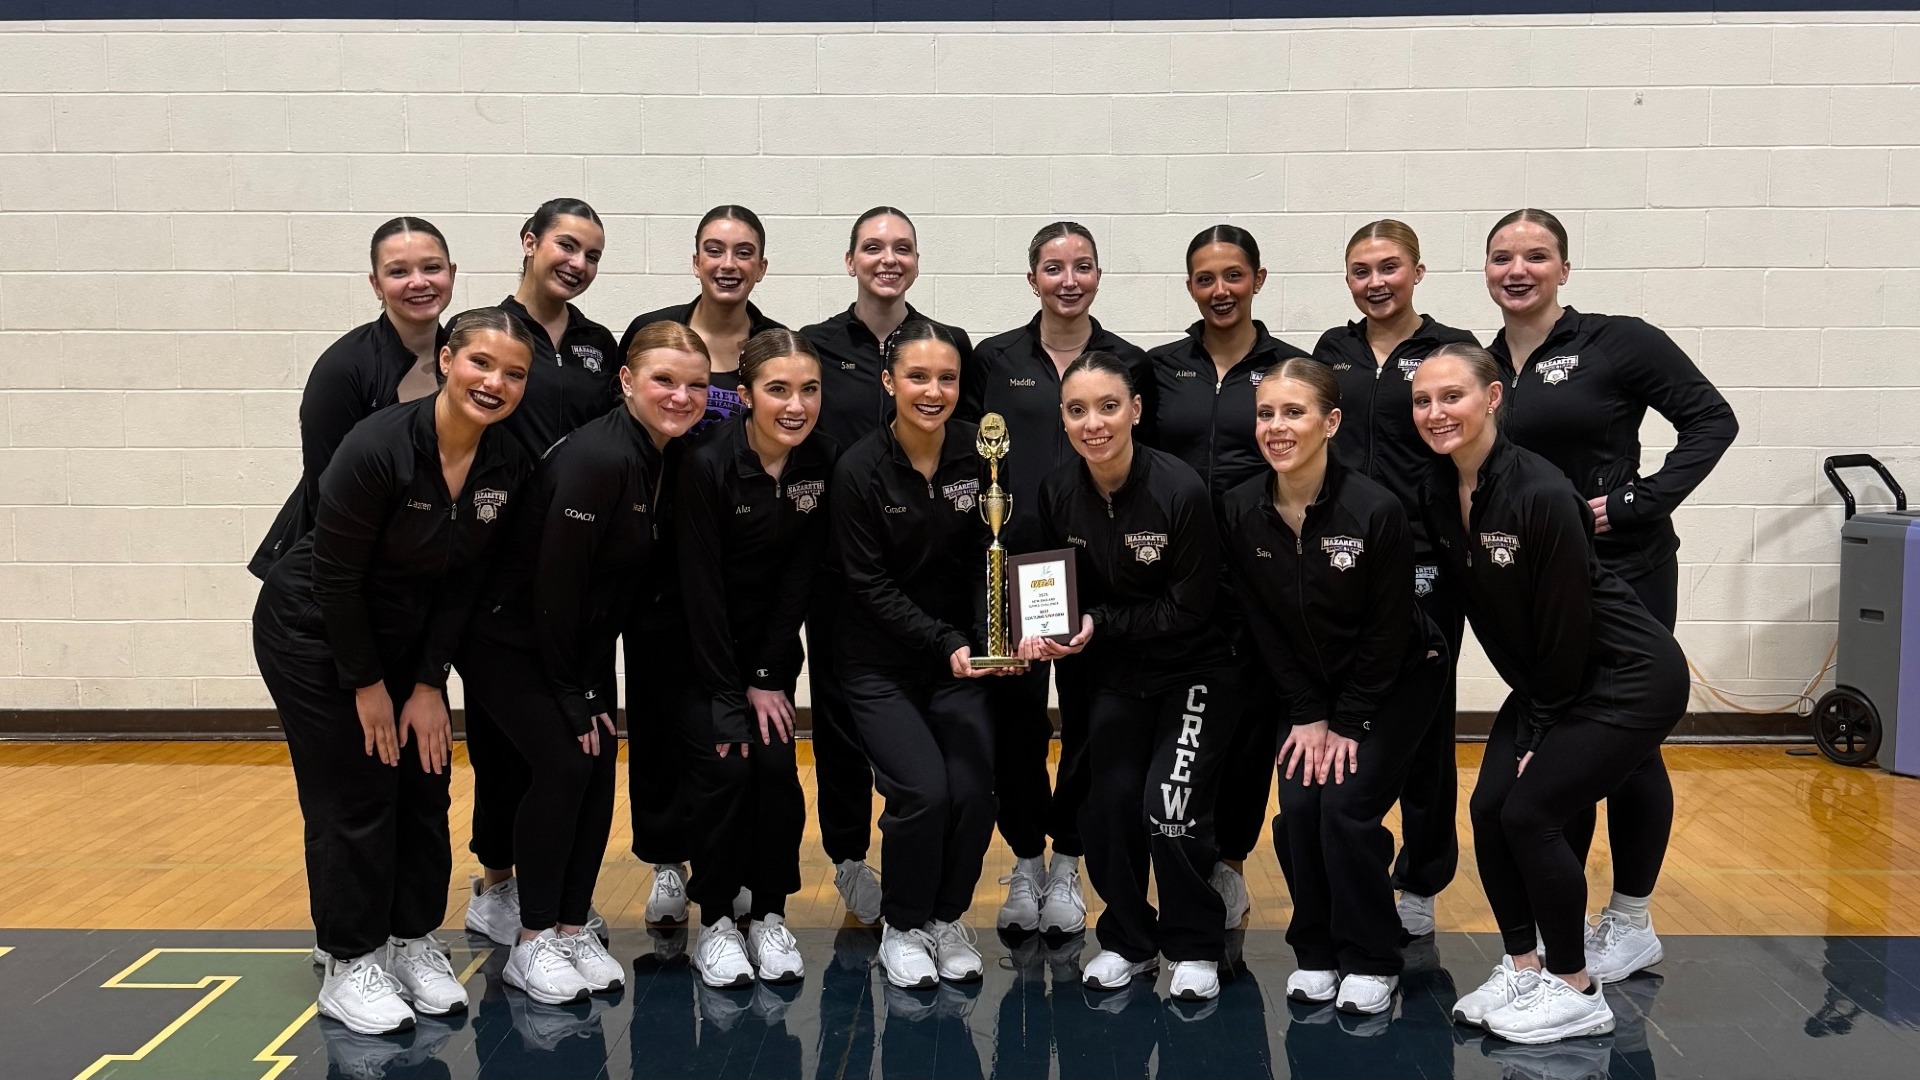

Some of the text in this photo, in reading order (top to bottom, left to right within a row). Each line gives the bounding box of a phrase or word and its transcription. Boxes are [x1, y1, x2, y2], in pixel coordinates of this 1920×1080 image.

[841, 361, 856, 370] Sam
[788, 482, 822, 493] NAZARETH
[944, 481, 978, 494] NAZARETH
[564, 508, 596, 522] COACH
[884, 505, 907, 514] Grace
[1127, 535, 1166, 543] NAZARETH
[1323, 539, 1362, 547] NAZARETH
[1160, 684, 1208, 821] CREW
[1162, 825, 1183, 836] USA
